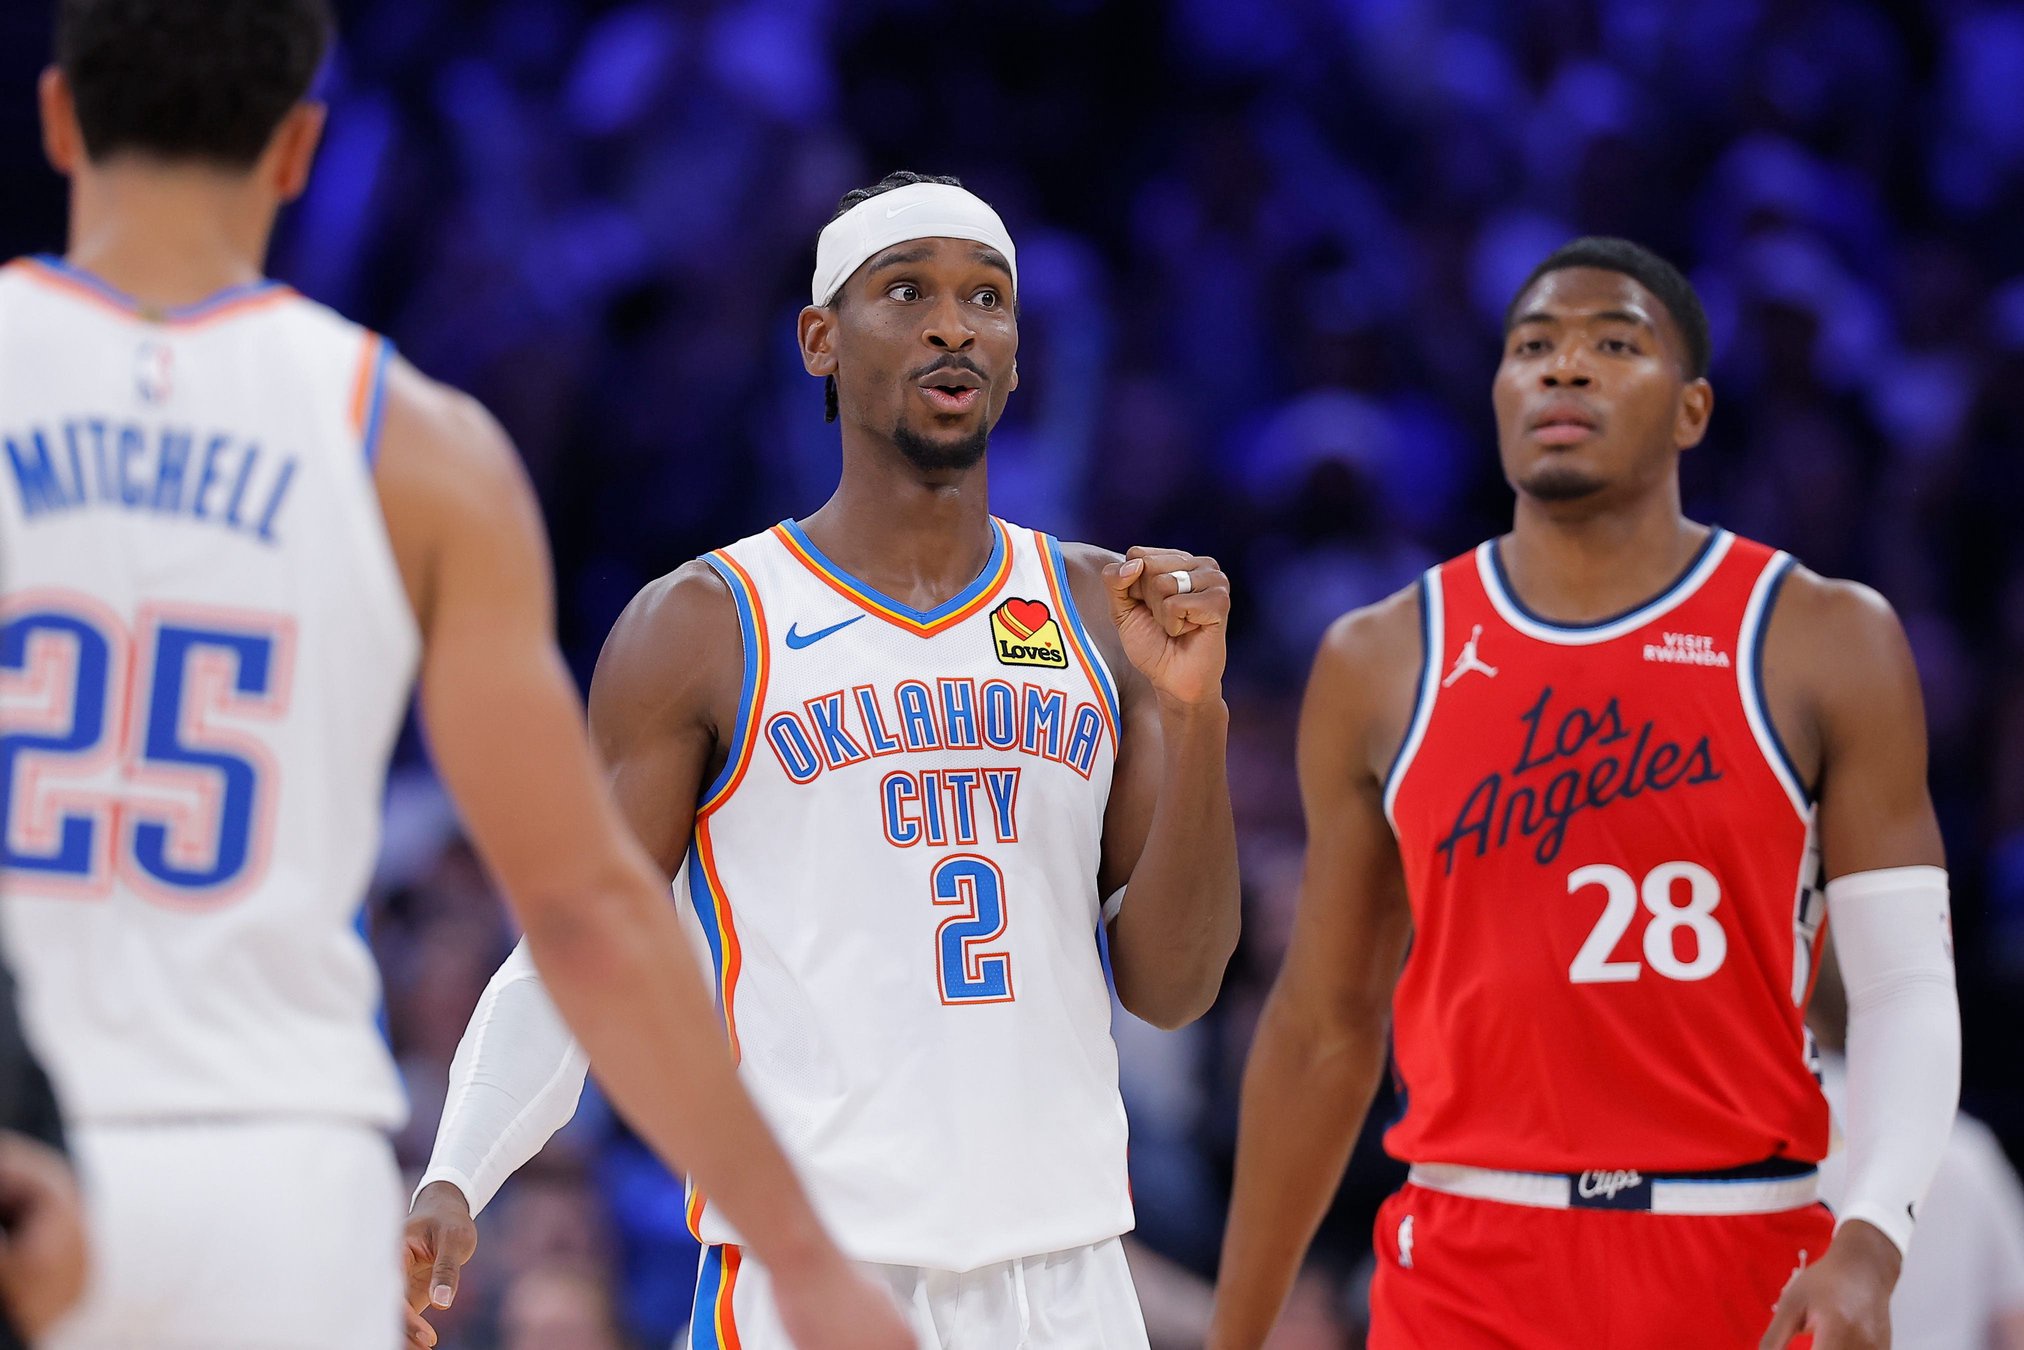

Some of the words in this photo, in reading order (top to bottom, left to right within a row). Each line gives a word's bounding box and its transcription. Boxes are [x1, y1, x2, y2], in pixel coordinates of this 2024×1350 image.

[3, 416, 297, 547] MITCHELL
[1643, 644, 1730, 668] RWANDA
[1663, 632, 1713, 650] VISIT
[0, 586, 299, 915] 25
[765, 677, 1103, 785] OKLAHOMA
[1511, 686, 1629, 777] Los
[880, 767, 1021, 848] CITY
[1437, 720, 1723, 876] Angeles
[930, 853, 1015, 1006] 2
[1567, 860, 1727, 983] 28
